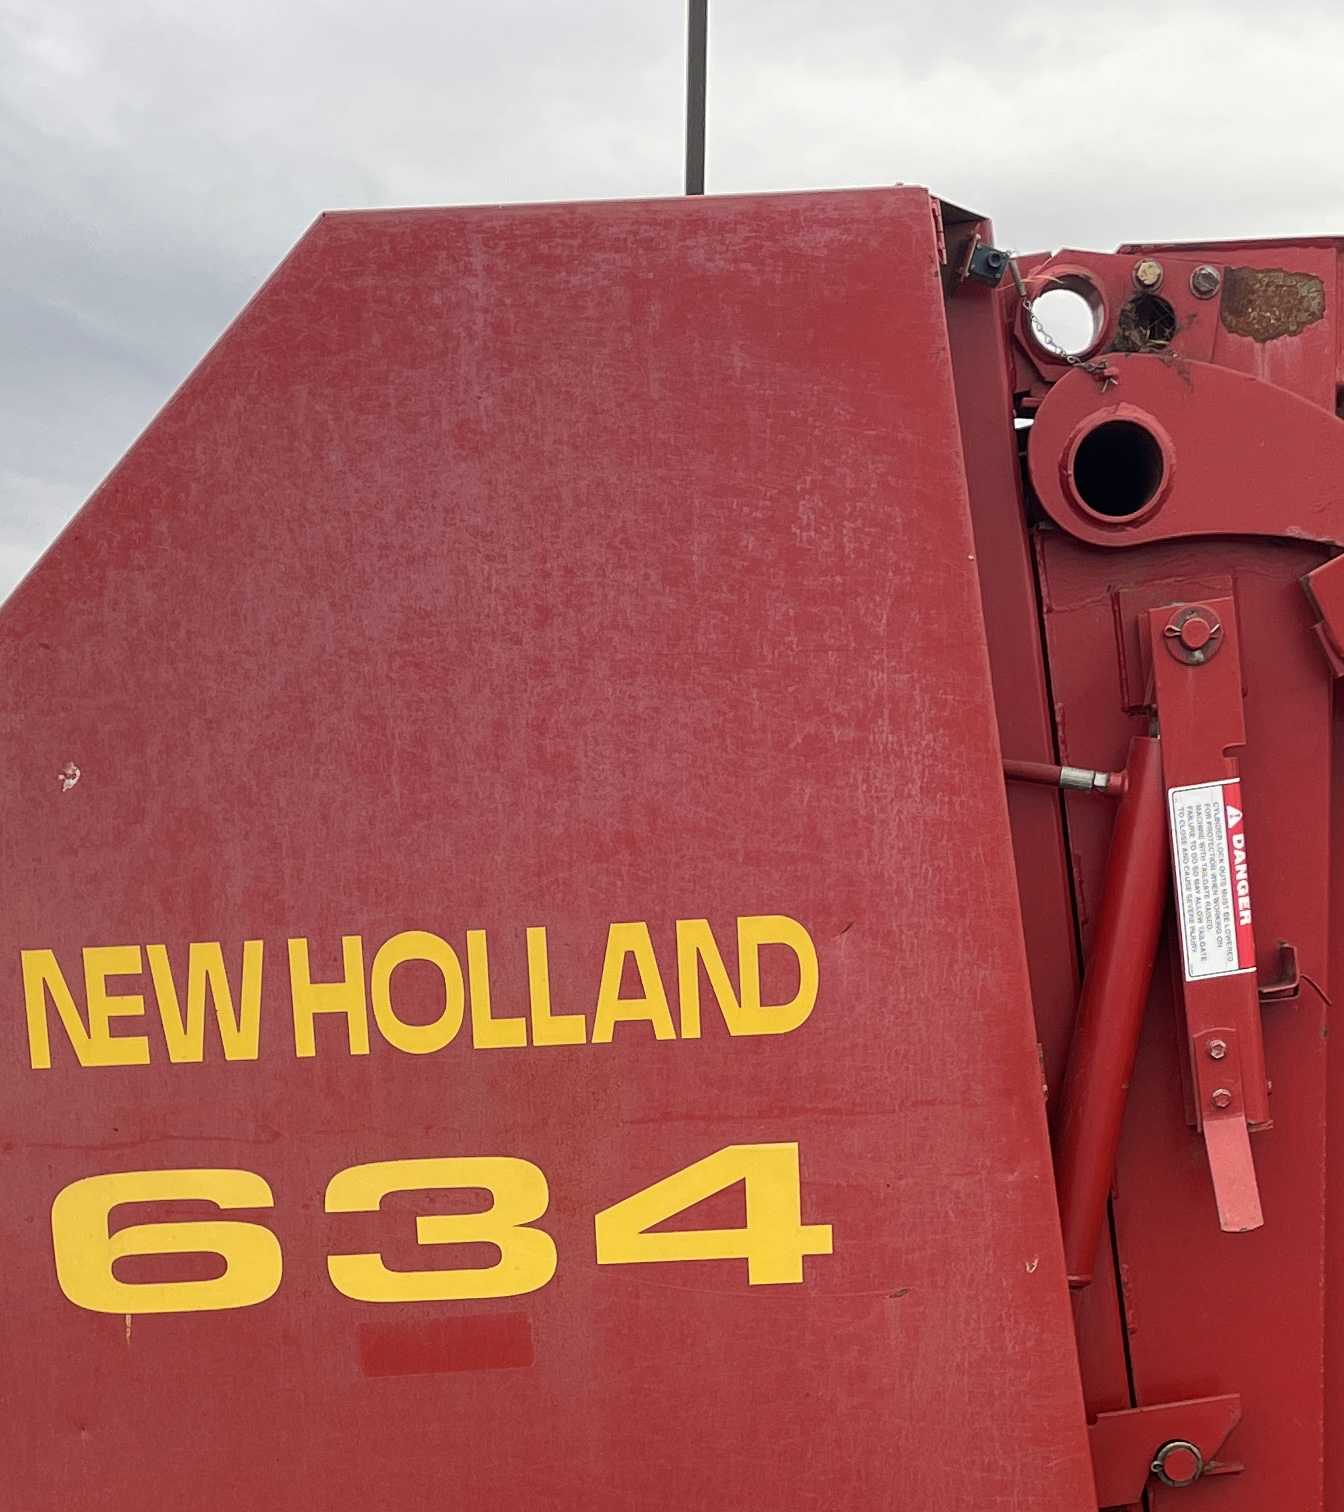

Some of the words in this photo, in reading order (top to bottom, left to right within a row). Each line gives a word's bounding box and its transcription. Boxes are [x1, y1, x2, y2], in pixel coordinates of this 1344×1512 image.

[1178, 807, 1184, 818] TO
[1186, 805, 1196, 838] FAILURE
[1196, 804, 1204, 840] MACHINE
[1204, 803, 1212, 819] FOR
[1212, 802, 1222, 841] CYLINDER
[1179, 820, 1188, 845] CLOSE
[1190, 840, 1197, 851] TO
[1206, 821, 1216, 870] PROTECTION
[1182, 848, 1190, 864] AND
[1191, 852, 1198, 864] DO
[1199, 841, 1207, 861] WITH
[1184, 866, 1192, 892] CAUSE
[1192, 866, 1199, 877] SO
[1202, 863, 1210, 899] TAILGATE
[1210, 873, 1218, 896] WHEN
[1232, 833, 1251, 926] DANGER
[1186, 894, 1195, 925] SEVERE
[1196, 896, 1204, 924] ALLOW
[1213, 897, 1223, 934] WORKING
[1223, 911, 1230, 922] BE
[1198, 926, 1207, 961] TAILGATE
[1216, 936, 1223, 948] ON
[1224, 924, 1233, 962] LOWERED
[20, 939, 264, 1069] NEW
[287, 914, 820, 1059] HOLLAND
[50, 1142, 834, 1315] 634
